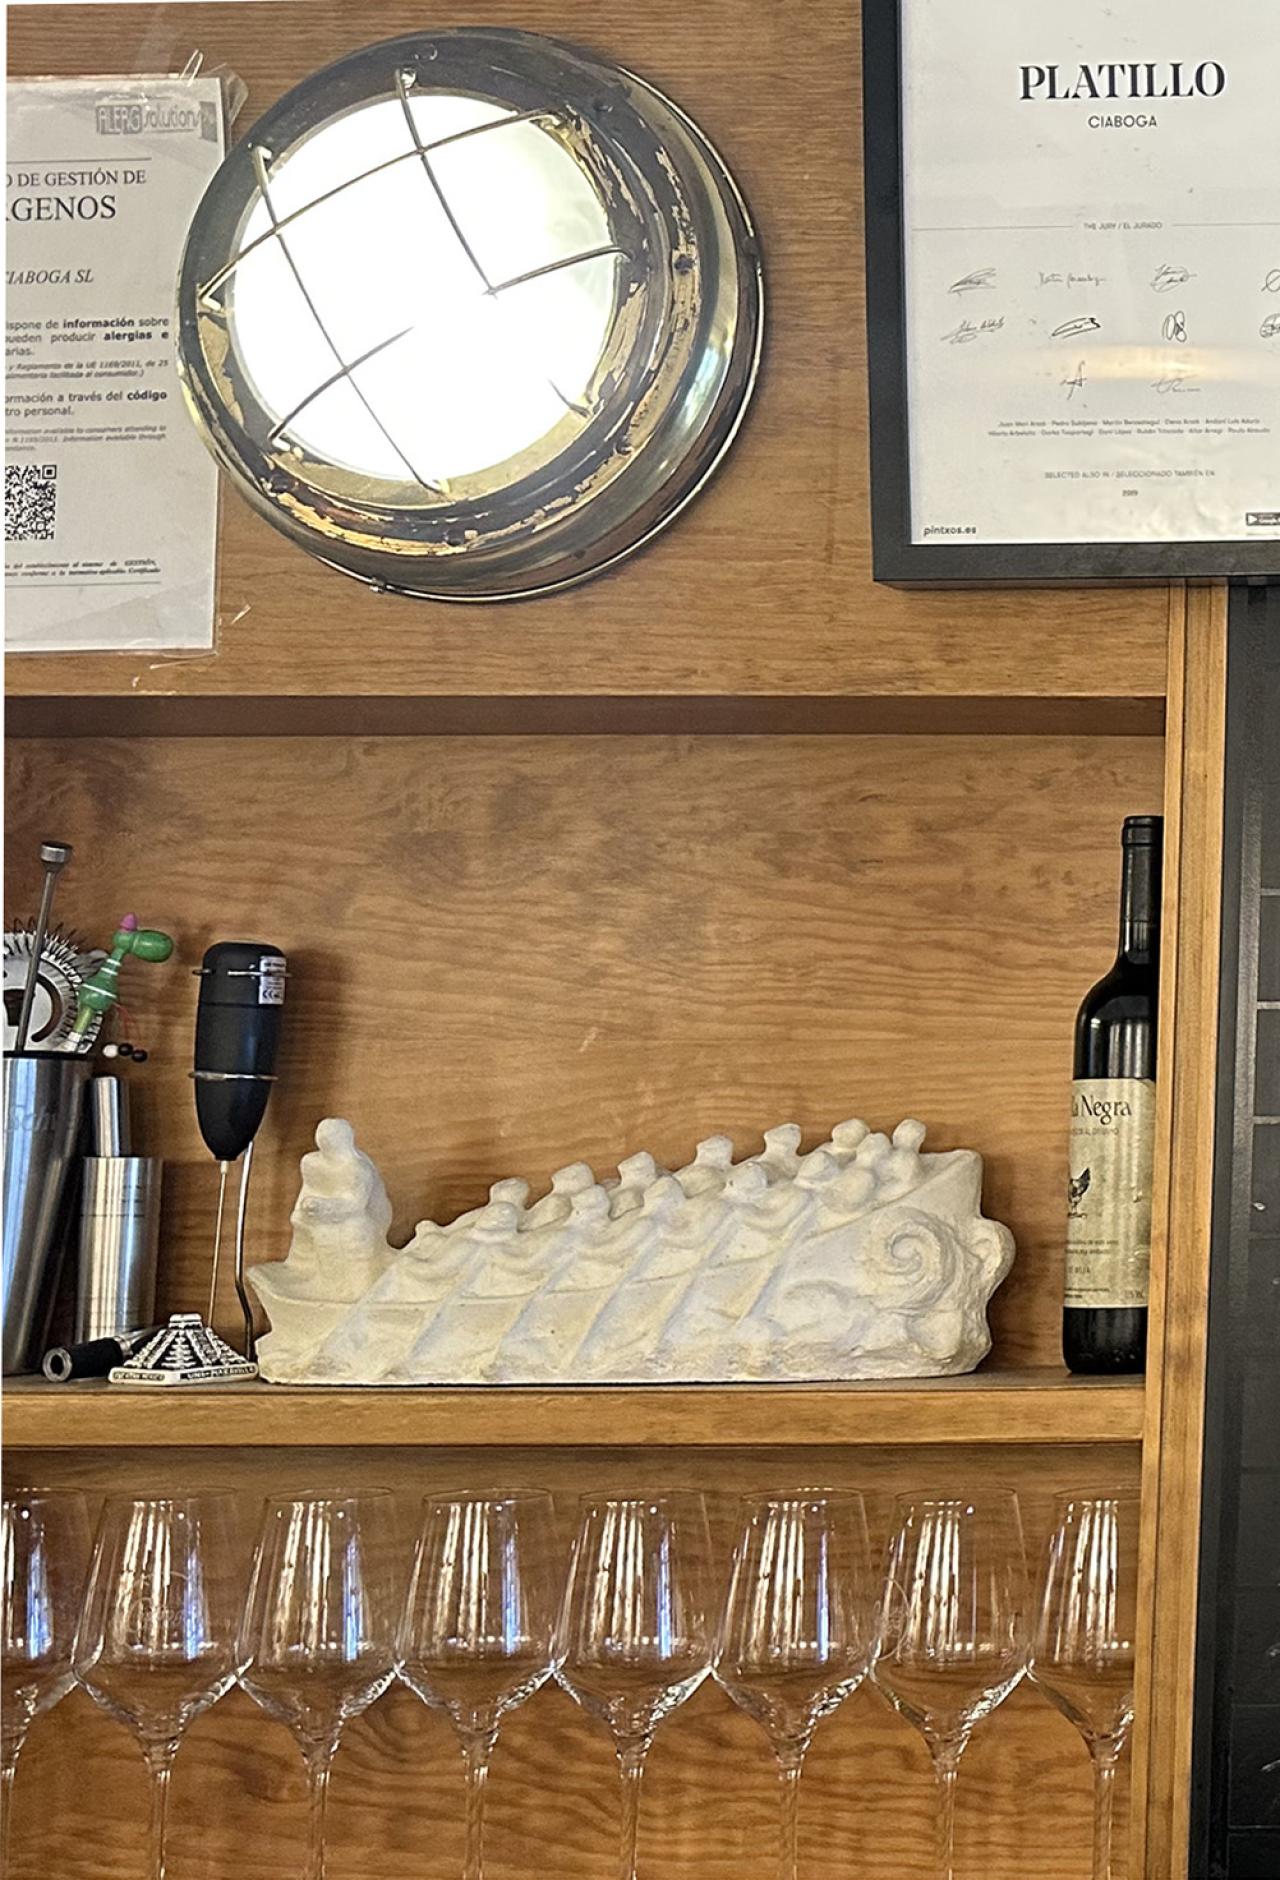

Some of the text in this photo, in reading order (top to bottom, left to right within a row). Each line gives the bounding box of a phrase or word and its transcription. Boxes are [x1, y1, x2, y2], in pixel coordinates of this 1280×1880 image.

[1019, 61, 1226, 101] PLATILLO
[1088, 115, 1158, 129] CIABOGA
[18, 172, 40, 187] DE
[45, 167, 119, 186] GESTIÓN
[123, 170, 147, 185] DE
[74, 268, 94, 284] SL
[46, 319, 59, 329] de
[63, 318, 135, 329] información
[138, 316, 169, 327] sobre
[51, 331, 96, 345] producir
[104, 330, 153, 342] alergias
[161, 332, 169, 340] e
[57, 394, 65, 402] a
[68, 391, 102, 402] través
[105, 390, 124, 402] del
[127, 389, 168, 403] código
[923, 525, 977, 537] pintxos.es
[1081, 1094, 1133, 1126] Negra
